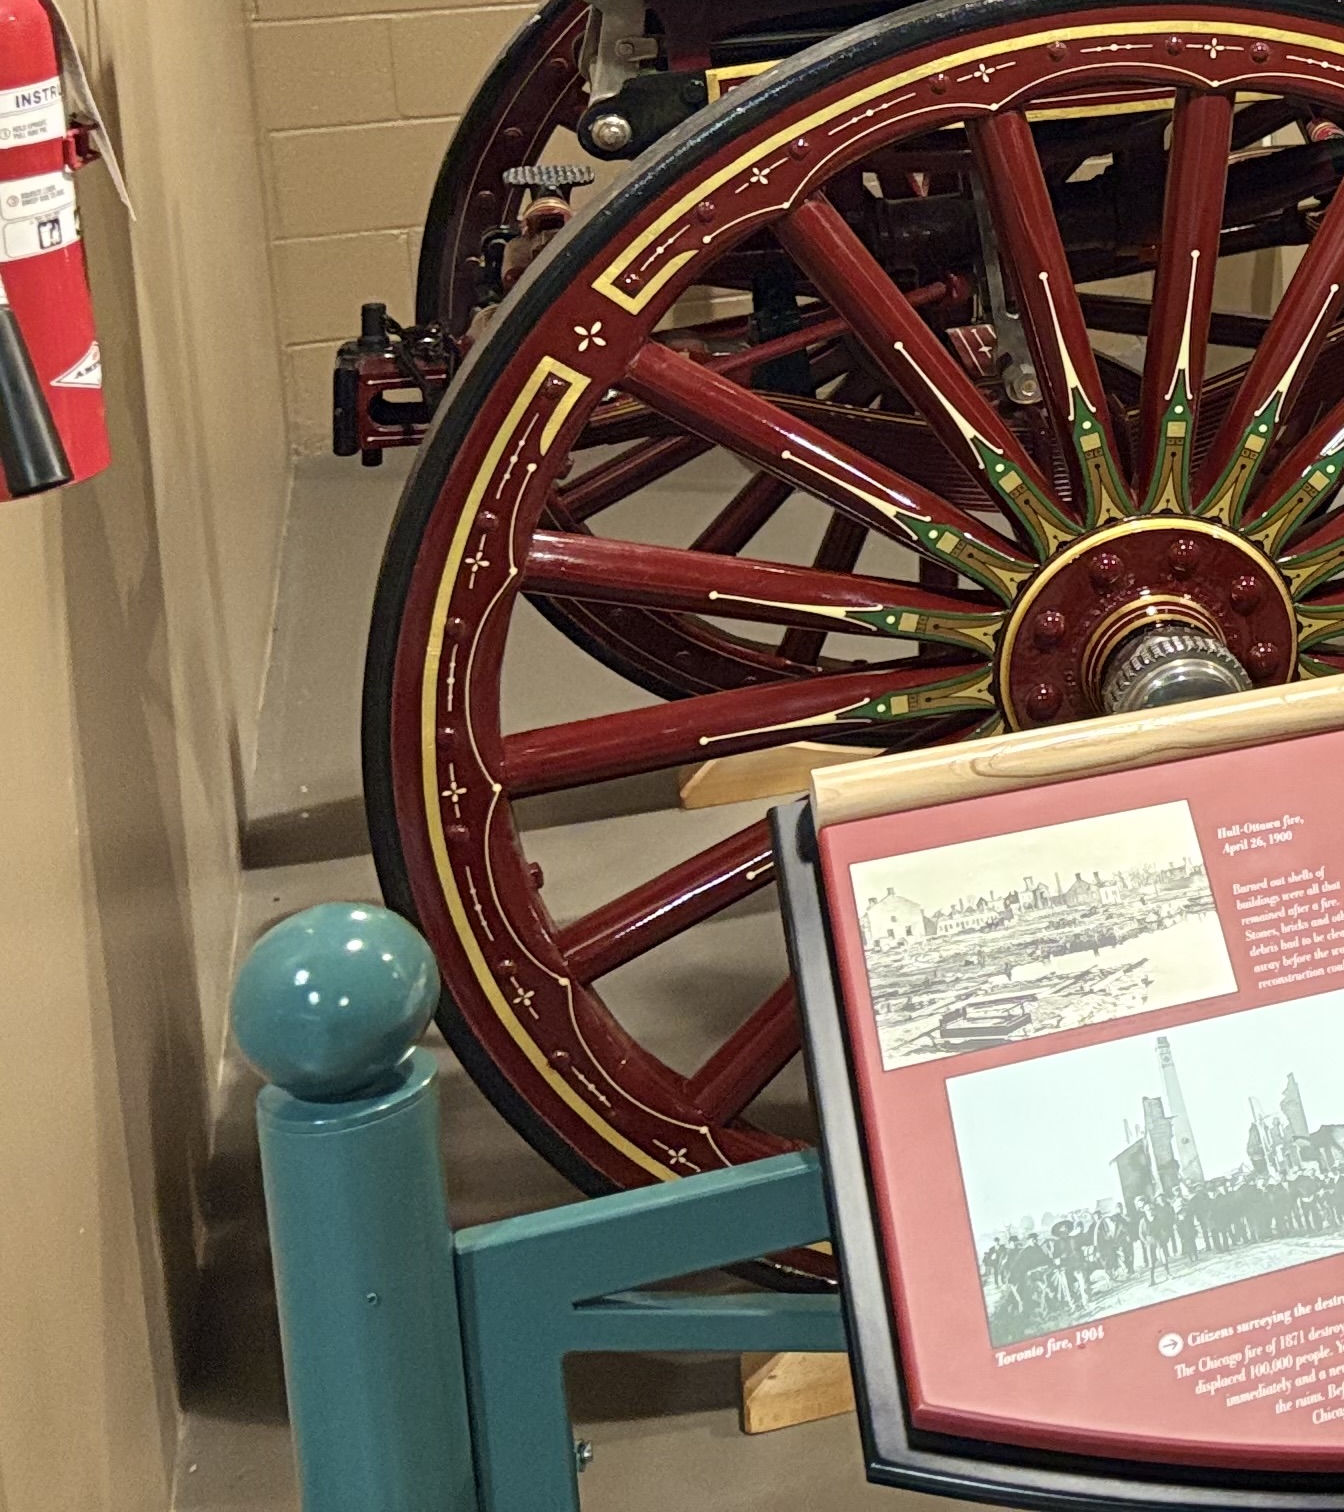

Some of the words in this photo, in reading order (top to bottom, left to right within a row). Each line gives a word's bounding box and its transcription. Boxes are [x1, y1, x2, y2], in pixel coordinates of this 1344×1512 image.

[1283, 815, 1304, 829] fire,
[1223, 839, 1248, 856] April
[1250, 837, 1266, 848] 26,
[1269, 831, 1292, 844] 1900
[1188, 1327, 1234, 1346] Citizens
[1237, 1311, 1292, 1333] surveying
[1294, 1304, 1311, 1317] the
[996, 1346, 1044, 1366] Toronto
[1046, 1339, 1072, 1358] fire,
[1076, 1328, 1104, 1345] 1904
